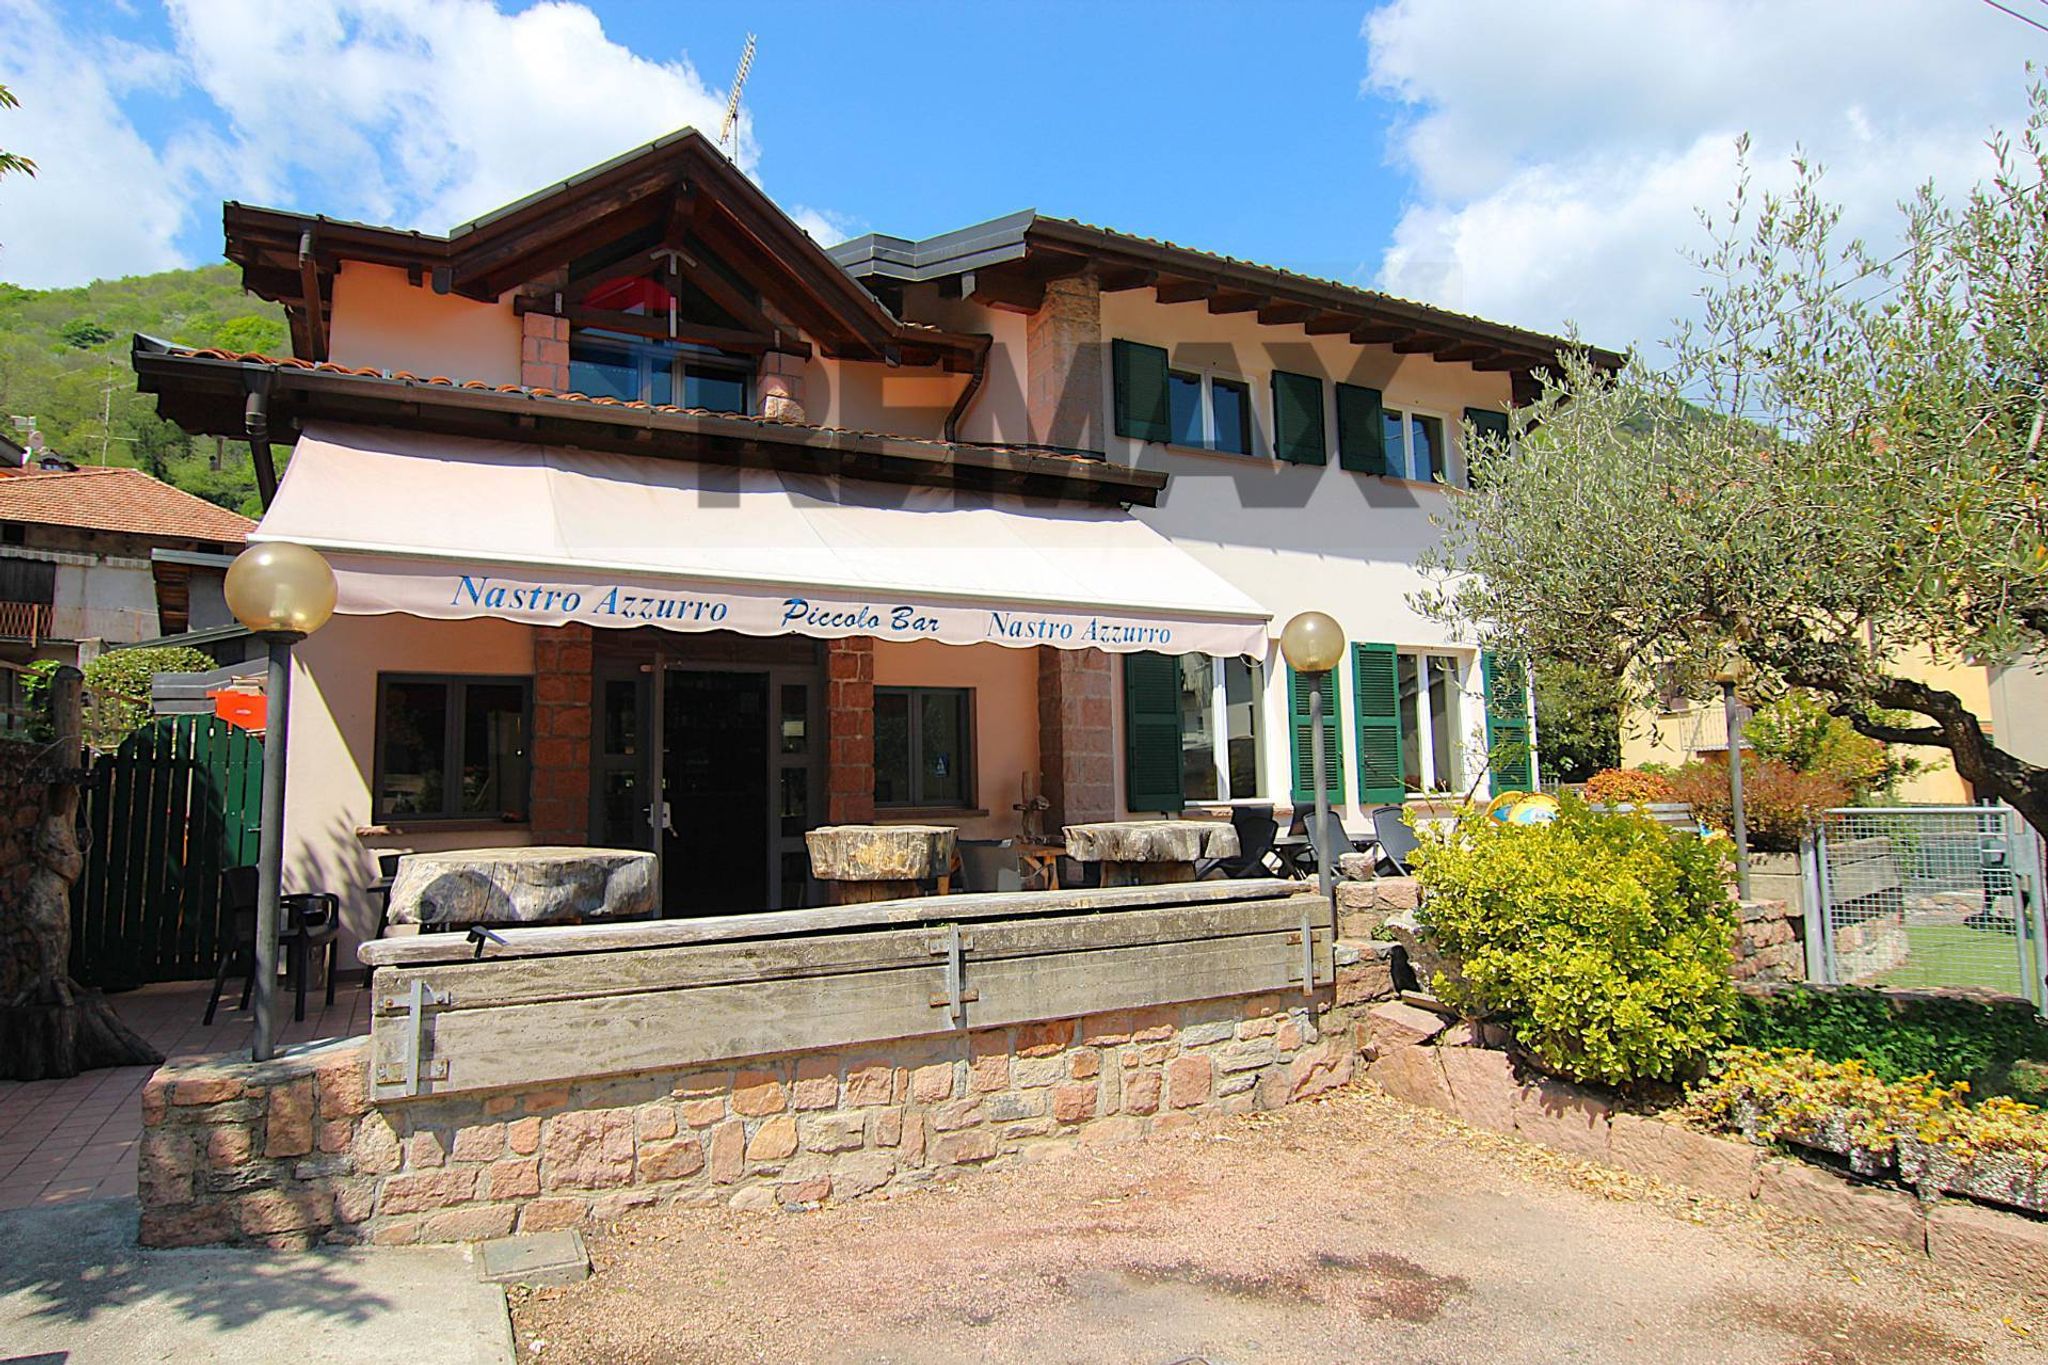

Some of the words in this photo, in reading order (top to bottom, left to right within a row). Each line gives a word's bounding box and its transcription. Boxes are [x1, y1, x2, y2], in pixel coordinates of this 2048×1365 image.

[451, 575, 582, 613] Nastro
[594, 586, 729, 623] Azzurro
[781, 598, 880, 627] Piccolo
[890, 606, 941, 632] Bar
[986, 611, 1074, 641] Nastro
[1080, 617, 1173, 644] Azzurro
